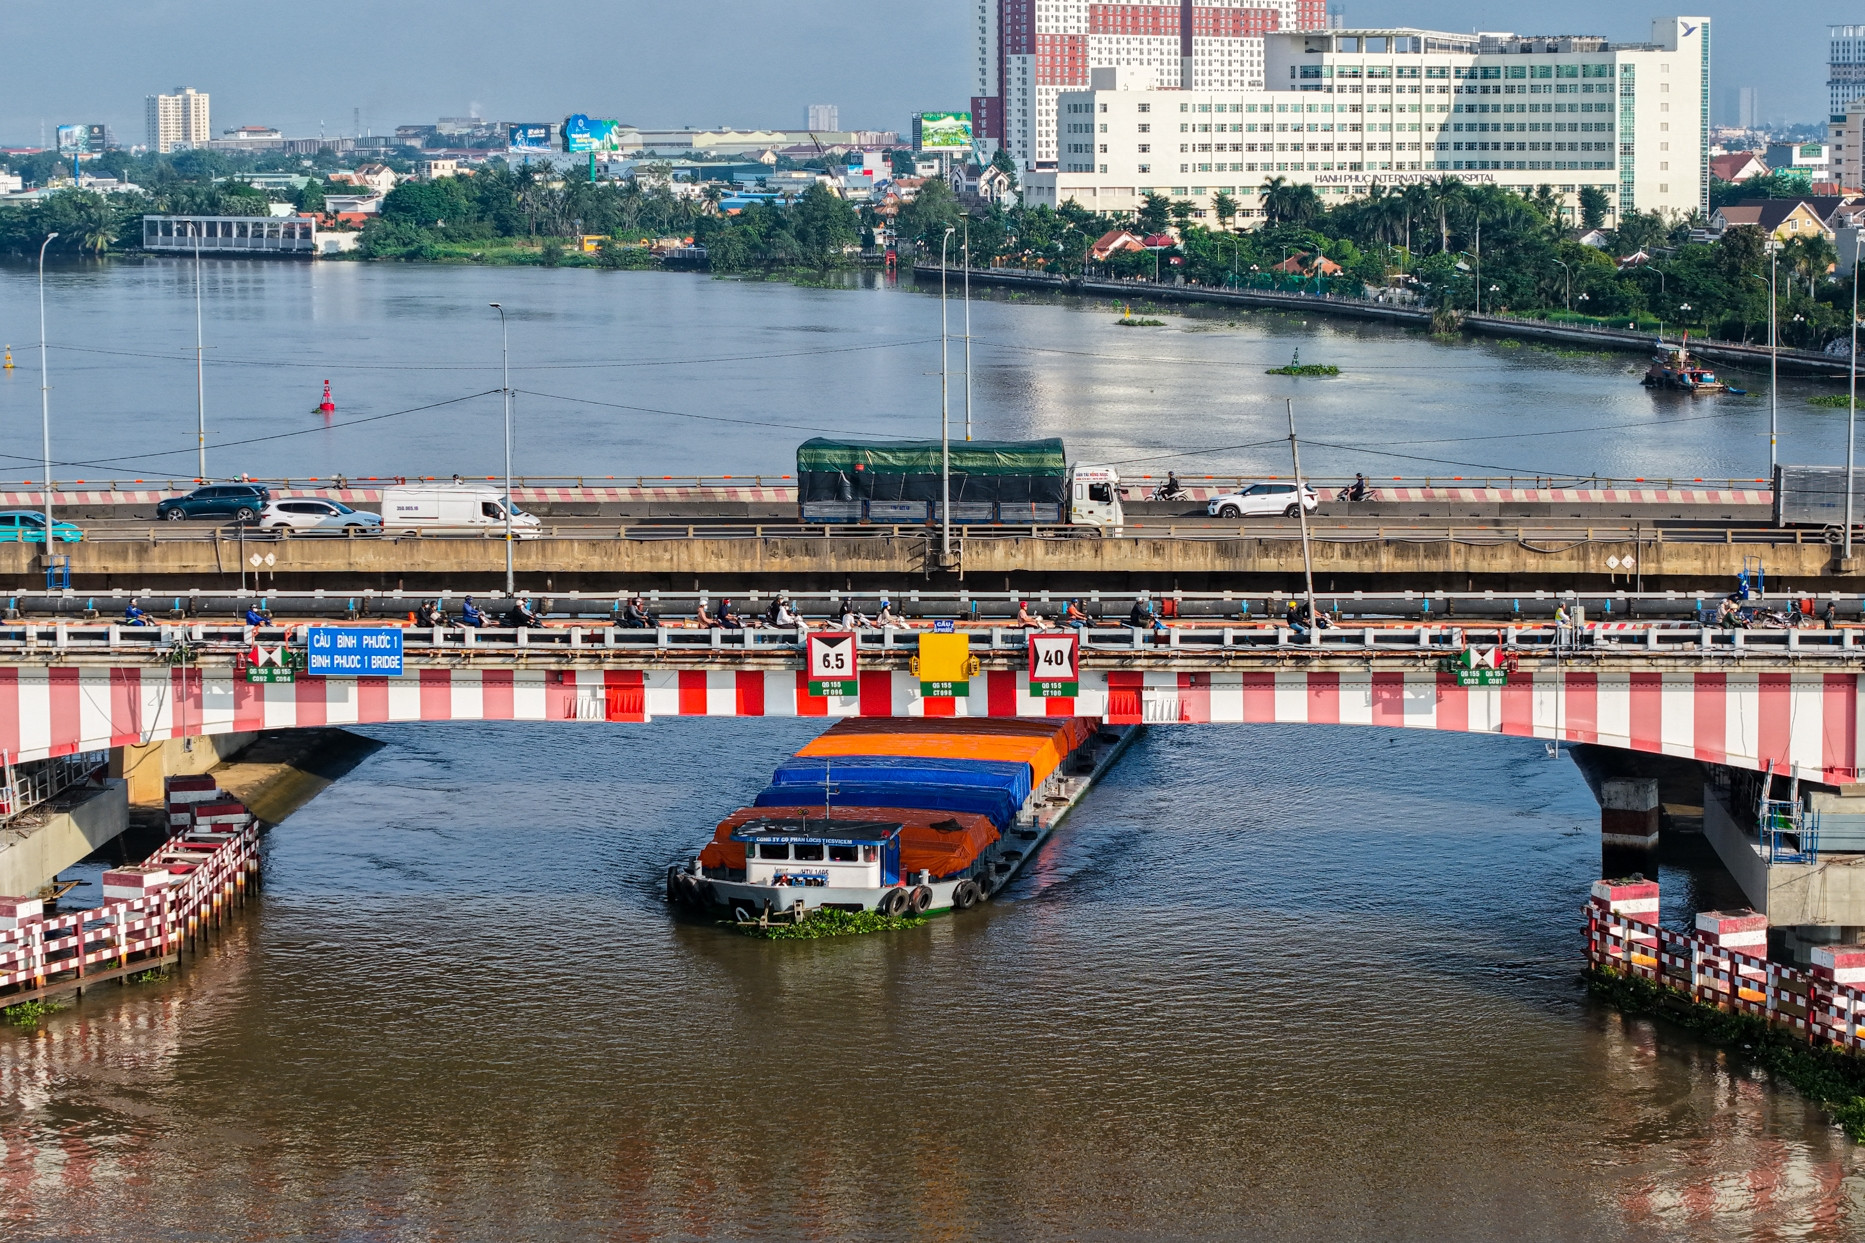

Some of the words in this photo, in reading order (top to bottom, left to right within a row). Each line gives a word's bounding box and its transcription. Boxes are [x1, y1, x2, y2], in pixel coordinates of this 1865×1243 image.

[1315, 174, 1342, 182] HANH
[1344, 174, 1371, 182] PHUC
[1373, 174, 1447, 182] INTERNATIONA
[313, 630, 331, 648] CẦU
[337, 632, 357, 648] BÌNH
[362, 632, 391, 649] PHƯỚC
[394, 636, 398, 648] 1
[311, 655, 331, 667] BINH
[334, 655, 361, 668] PHUOC
[364, 656, 368, 668] 1
[371, 656, 400, 668] BRIDGE
[822, 653, 845, 669] 6.5
[1044, 649, 1064, 666] 40
